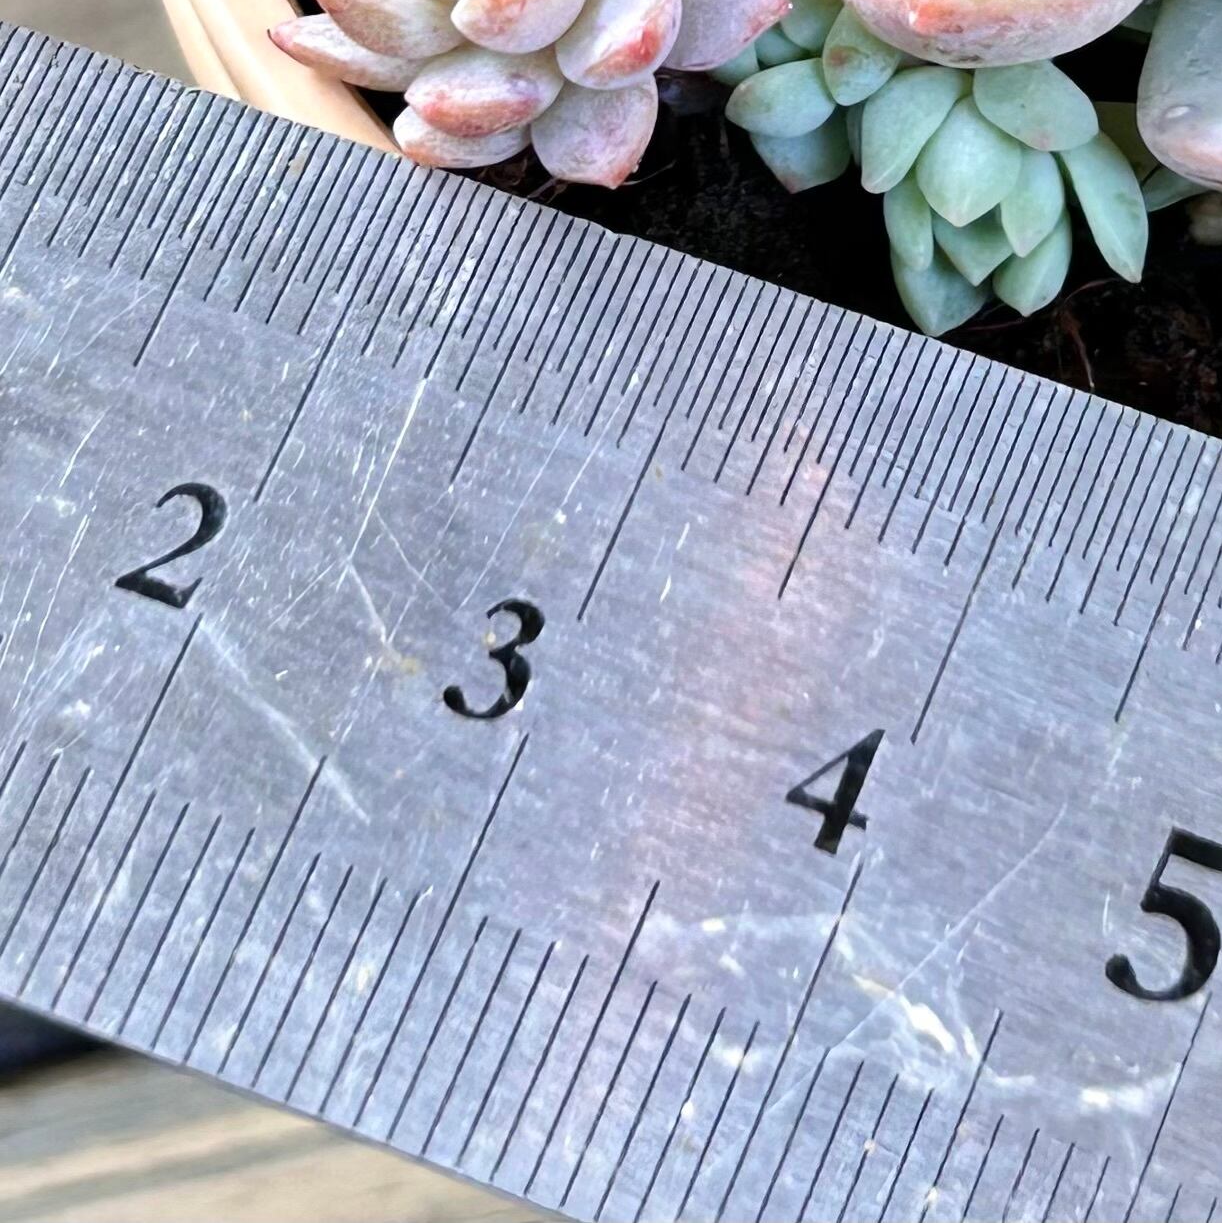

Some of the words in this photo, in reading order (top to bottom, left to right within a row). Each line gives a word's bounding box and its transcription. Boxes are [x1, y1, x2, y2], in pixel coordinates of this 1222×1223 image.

[115, 482, 227, 608] 2
[443, 599, 546, 720] 3
[785, 729, 885, 854] 4
